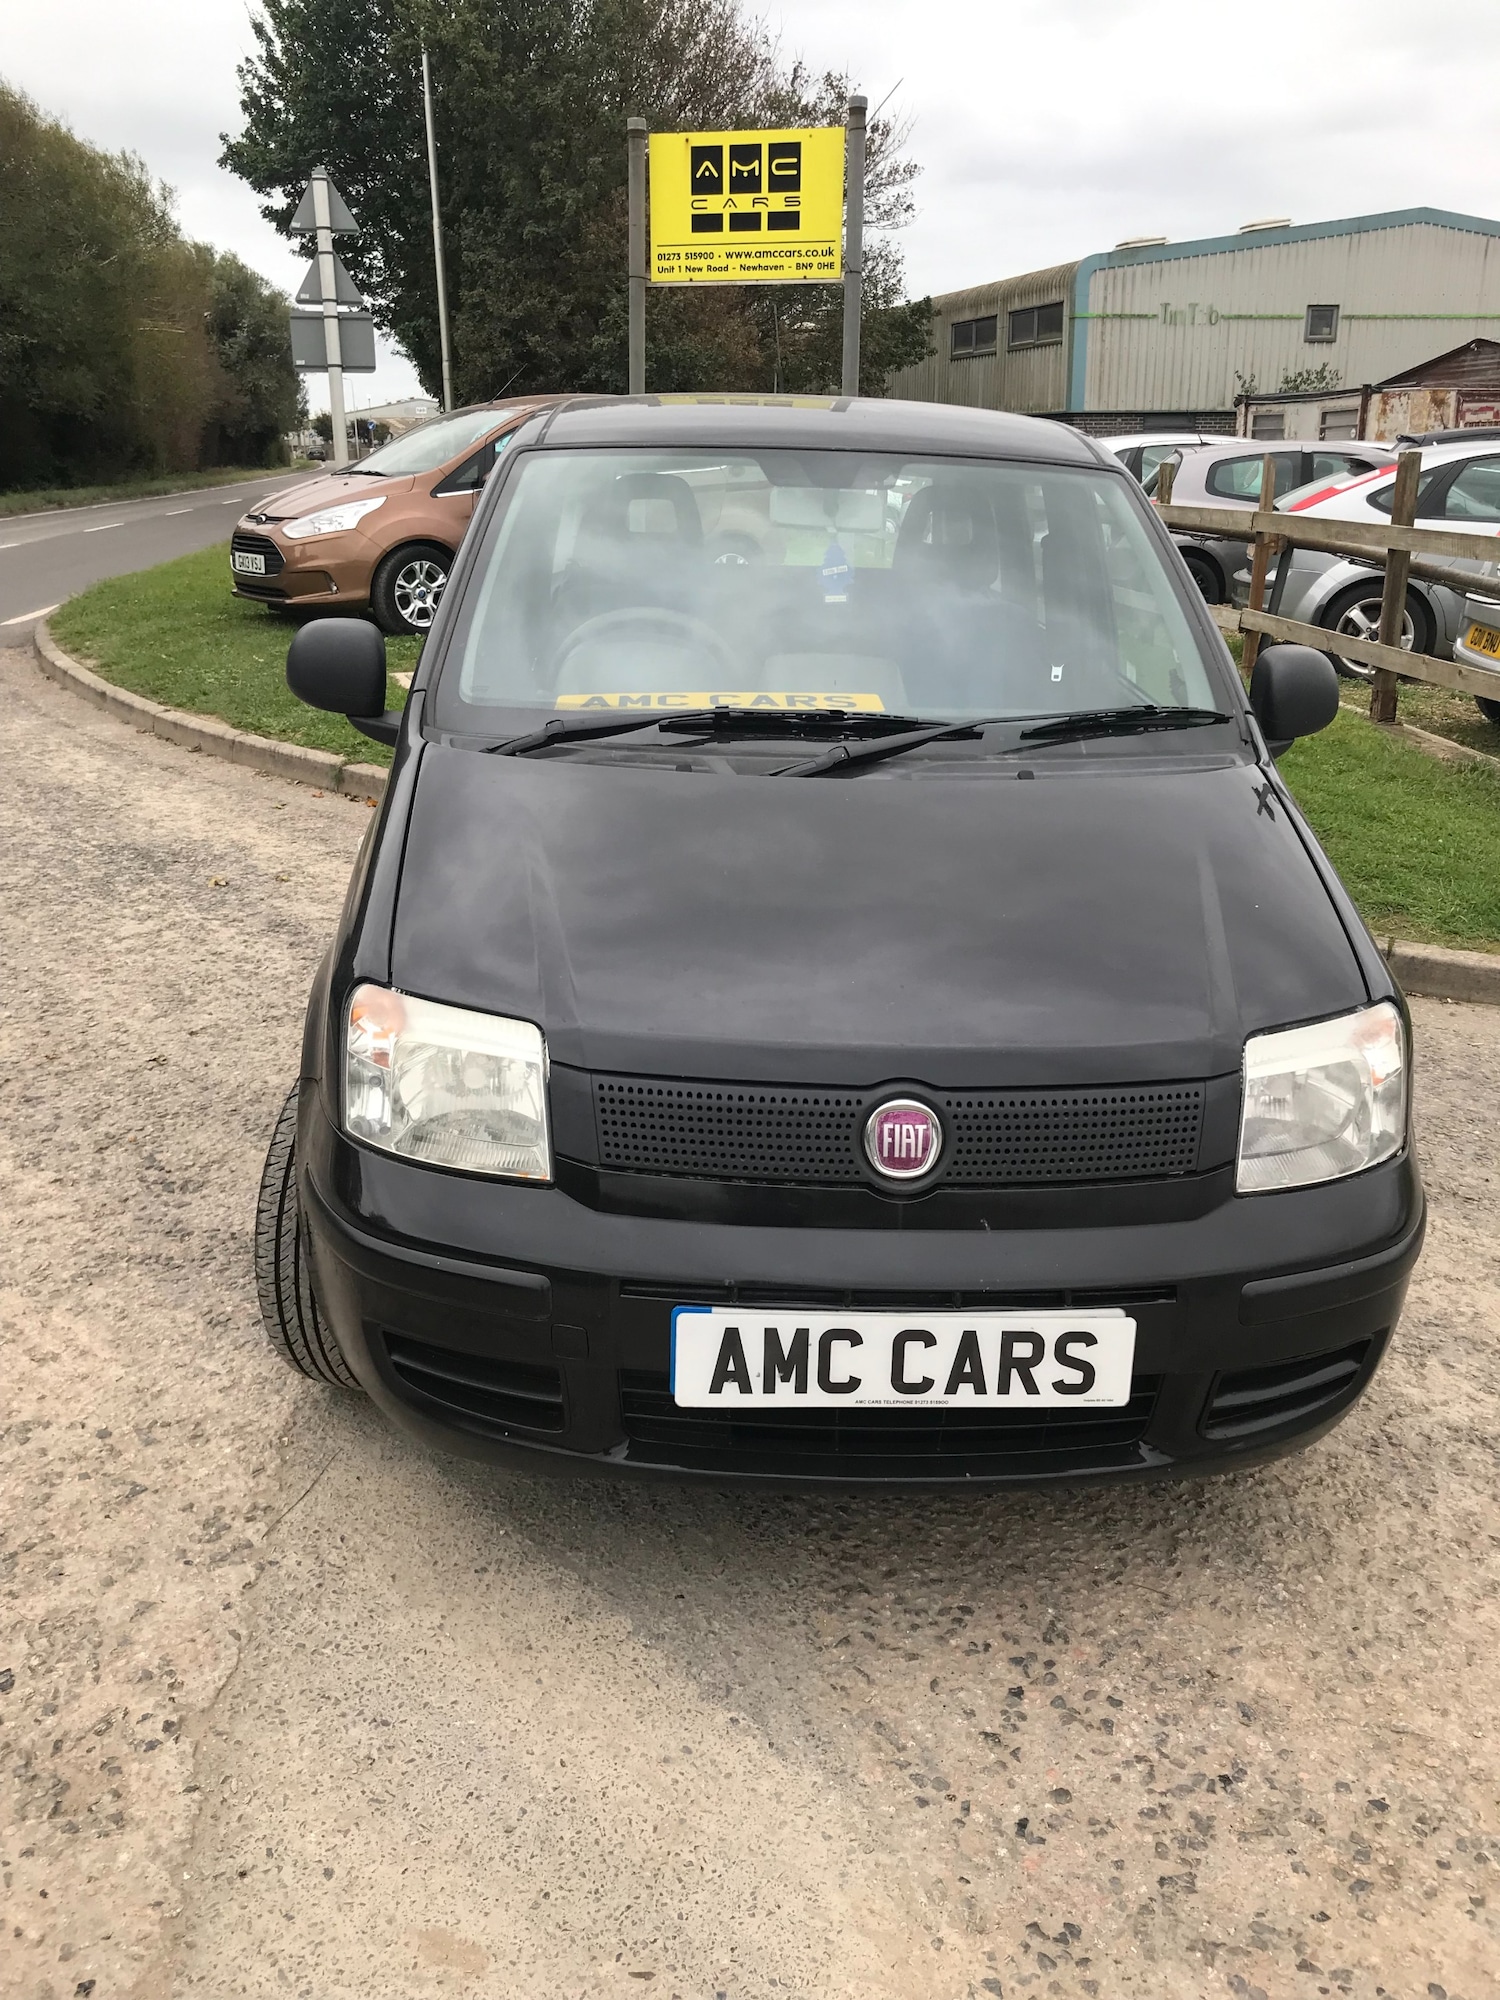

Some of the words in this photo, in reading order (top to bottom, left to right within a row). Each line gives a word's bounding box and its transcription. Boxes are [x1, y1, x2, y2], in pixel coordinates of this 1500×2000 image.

[696, 158, 798, 179] AMC
[691, 196, 801, 210] CARS
[657, 252, 681, 261] 01273
[684, 251, 715, 260] 515900
[725, 246, 835, 259] www.amccars.co.uk
[657, 265, 675, 274] Unit
[678, 265, 682, 273] 1
[685, 264, 703, 273] New
[706, 264, 729, 272] Road
[739, 263, 785, 271] Newhaven
[795, 262, 814, 271] BN9
[580, 694, 690, 708] AMC
[709, 694, 858, 708] CARS
[882, 1123, 927, 1159] FIAT
[708, 1327, 864, 1395] AMC
[890, 1329, 1099, 1395] CARS
